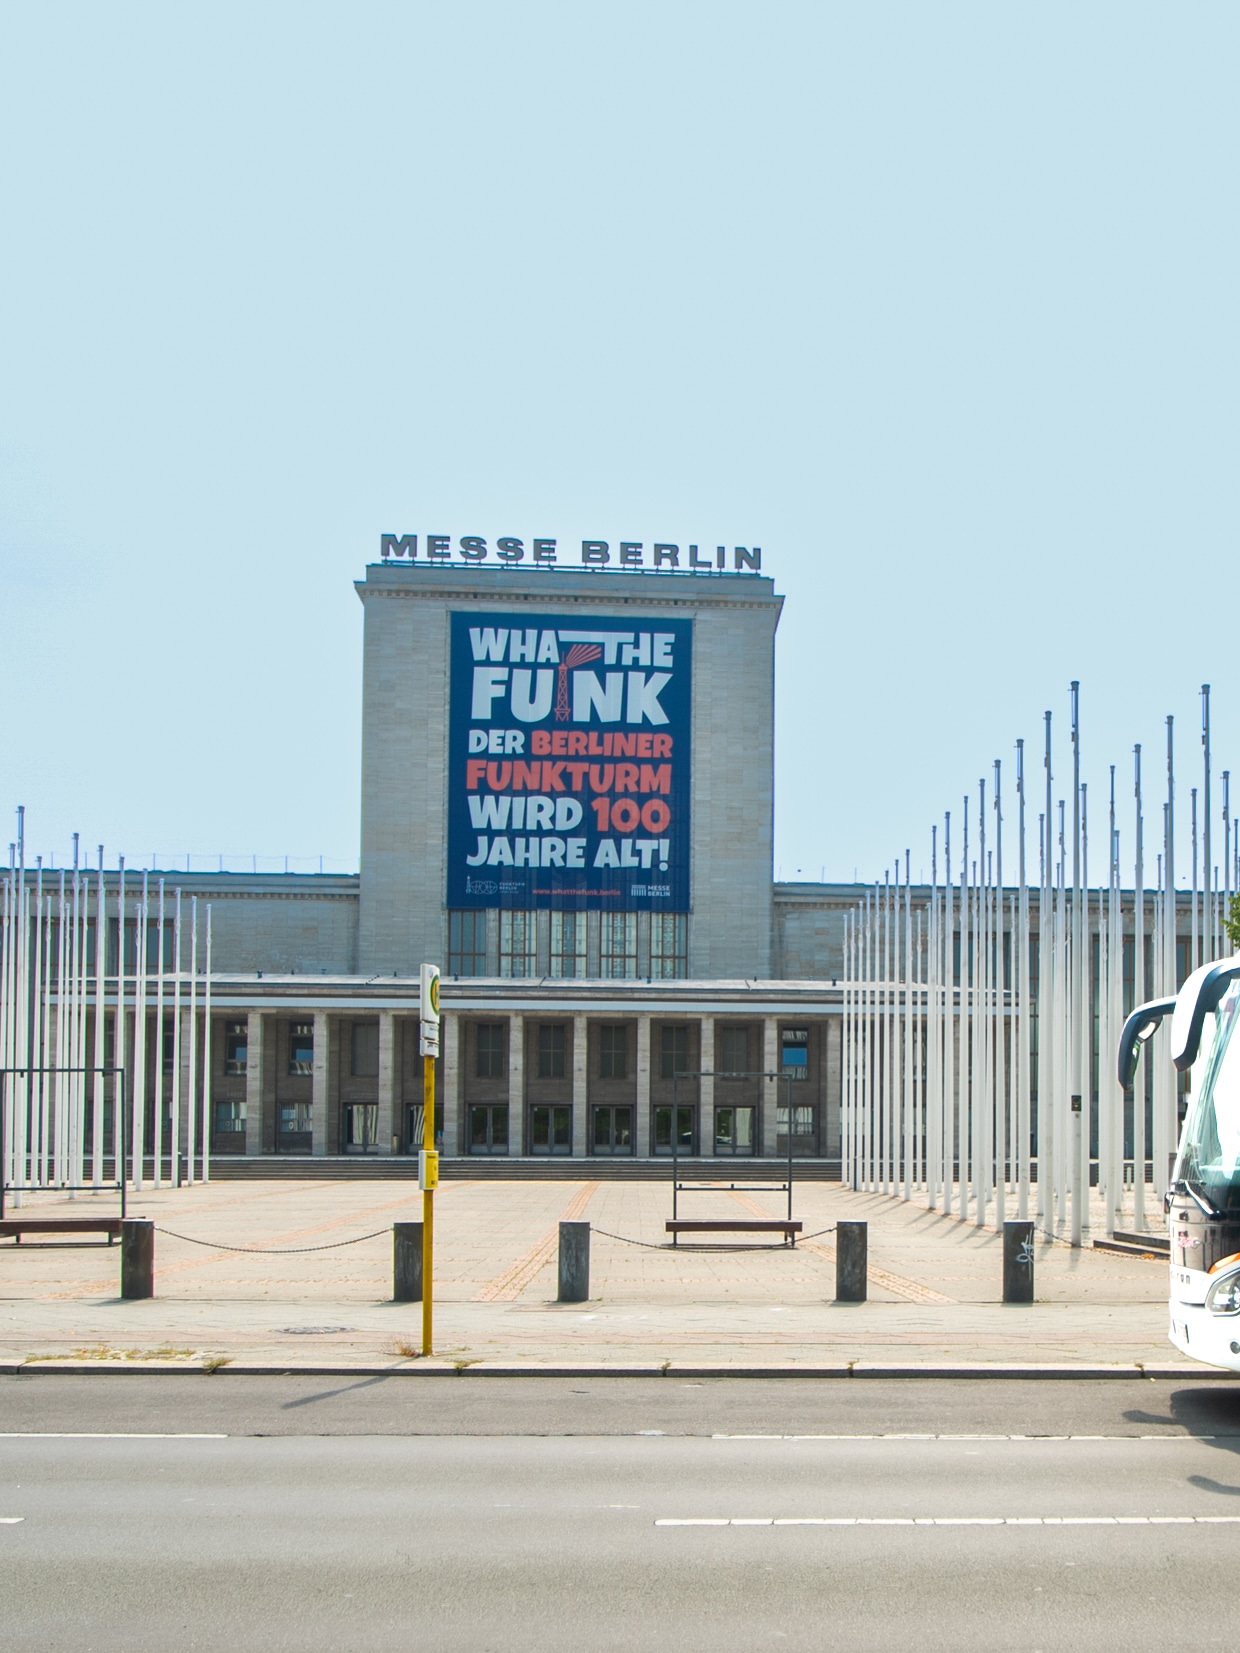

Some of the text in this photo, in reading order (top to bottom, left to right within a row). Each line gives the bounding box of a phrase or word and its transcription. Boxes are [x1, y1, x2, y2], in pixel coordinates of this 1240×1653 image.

[381, 534, 761, 570] MESSE BERLIN
[471, 666, 673, 726] FUNK
[468, 730, 672, 758] DER BERLINER
[466, 760, 671, 794] FUNKTURM
[467, 795, 670, 833] WIRD 100
[466, 836, 670, 871] JAHRE ALT!
[532, 888, 621, 897] www.whatthefunk.berlin
